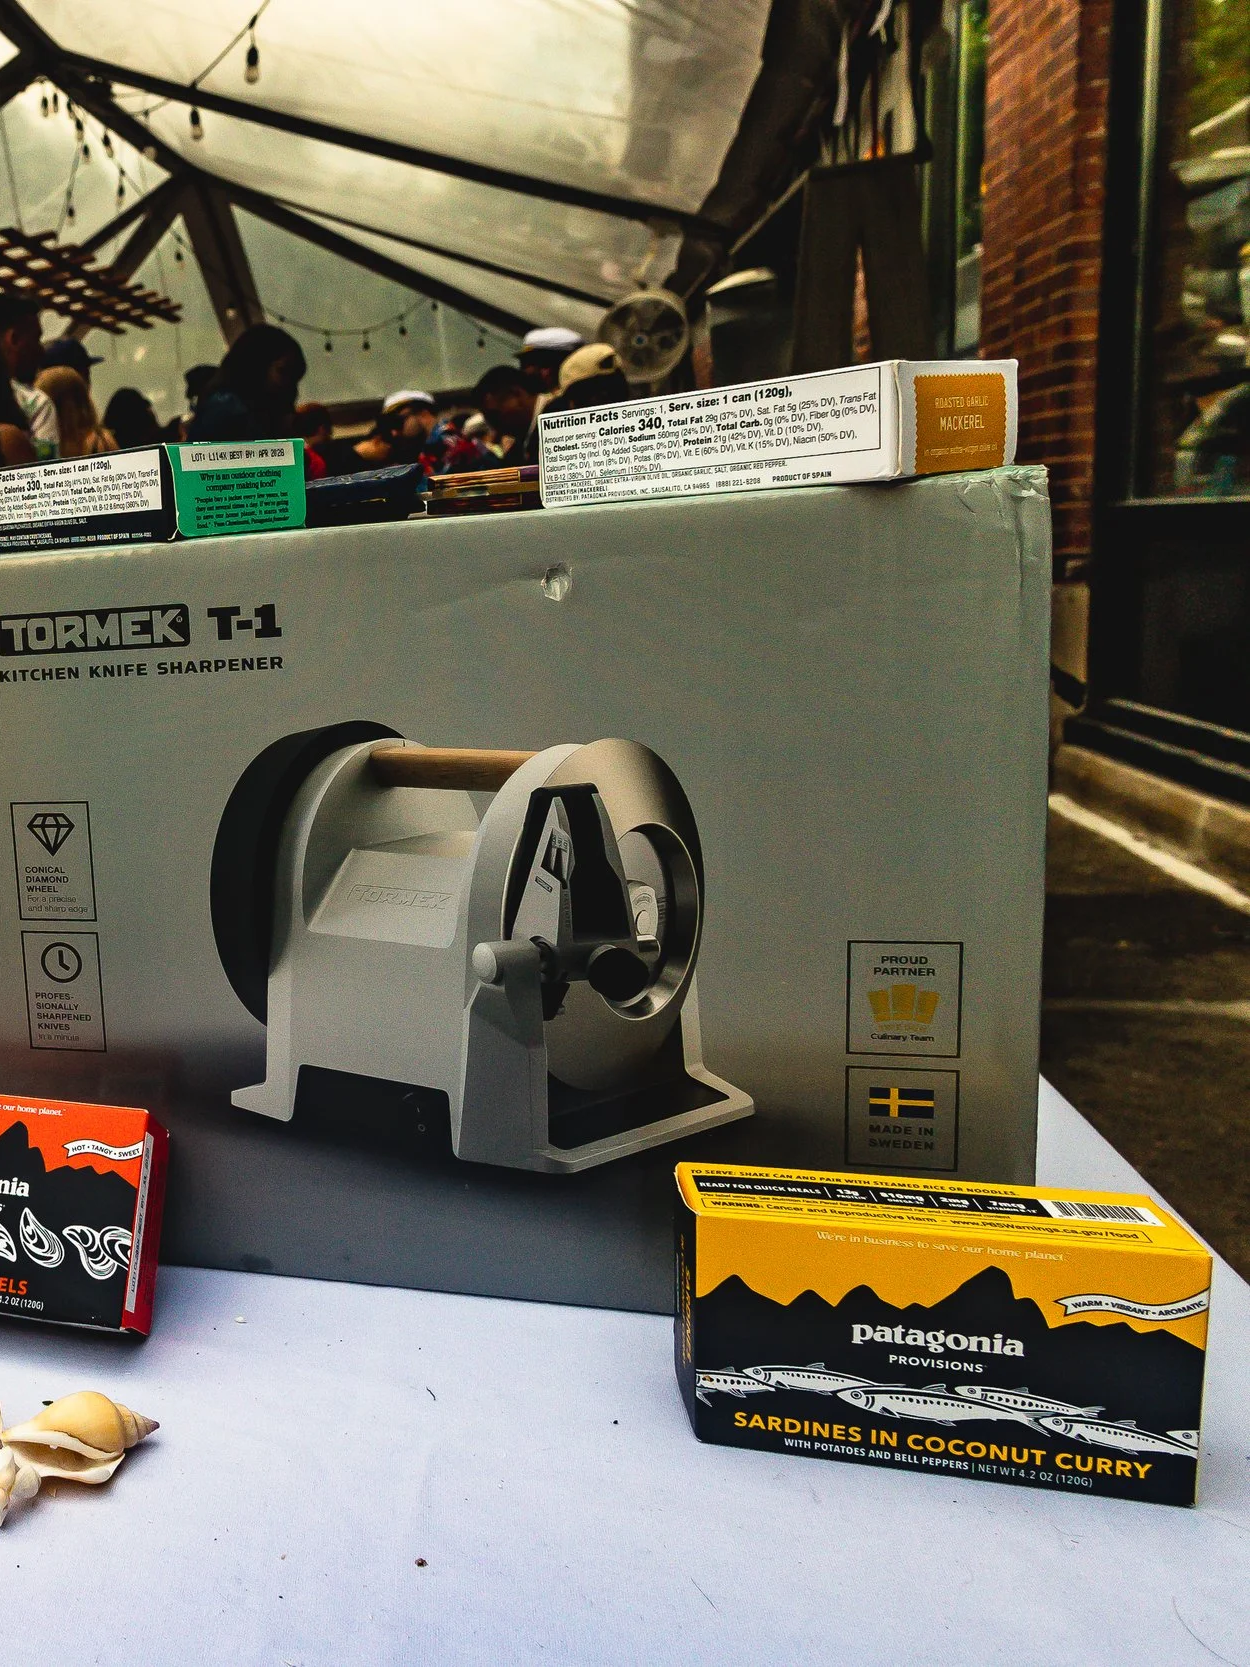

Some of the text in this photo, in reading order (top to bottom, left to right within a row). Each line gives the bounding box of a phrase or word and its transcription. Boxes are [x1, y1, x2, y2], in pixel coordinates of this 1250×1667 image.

[543, 416, 586, 430] Nutrition
[589, 411, 618, 423] Facts
[621, 406, 657, 419] Servings:
[668, 402, 693, 412] Serv.
[696, 398, 719, 408] size:
[731, 393, 751, 402] can
[754, 386, 792, 402] (120g),
[935, 395, 989, 408] ROASTED GARLIC
[940, 414, 985, 431] MACKEREL
[190, 452, 205, 462] LOT:
[228, 450, 243, 460] BEST
[245, 449, 255, 459] BY:
[258, 448, 269, 458] APR
[1, 603, 282, 652] TORMEK T-1
[0, 656, 283, 682] KITCHEN KNIFE SHARPENER
[25, 866, 65, 874] CONICAL
[26, 875, 69, 883] DIAMOND
[26, 885, 59, 893] WHEEL
[881, 956, 928, 965] PROUD
[874, 967, 936, 977] PARTNER
[35, 992, 74, 1000] PROFES-
[36, 1002, 79, 1011] SIONALLY
[37, 1012, 92, 1022] SHARPENED
[37, 1022, 70, 1031] KNIVES
[871, 1033, 935, 1042] Culinary Team
[16, 1104, 37, 1113] home
[869, 1124, 934, 1136] MADE IN
[71, 1144, 140, 1158] HOT TANGY SWEET
[868, 1138, 934, 1150] SWEDEN
[873, 1180, 920, 1189] STEAMED
[966, 1187, 1018, 1195] NOODLES.
[711, 1200, 765, 1209] WARNING:
[766, 1204, 805, 1213] Cancer
[807, 1207, 828, 1215] and
[830, 1208, 905, 1222] Reproductive
[908, 1215, 937, 1224] Harm
[816, 1231, 846, 1241] We're
[849, 1233, 862, 1242] in
[863, 1235, 913, 1247] business
[917, 1240, 929, 1248] to
[932, 1243, 958, 1251] save
[961, 1246, 983, 1255] our
[986, 1246, 1021, 1257] home
[10, 1296, 19, 1305] OZ
[20, 1298, 43, 1310] (120G)
[1071, 1300, 1206, 1316] WARM VIBRANT AROMATIC
[851, 1323, 1025, 1357] patagonia
[889, 1354, 984, 1373] PROVISIONS
[734, 1411, 1151, 1478] SARDINES IN COCONUT CURRY
[784, 1437, 1093, 1488] WITH POTATOES AND BELL PEPPERS NET WT 4.2 OZ (120G)
